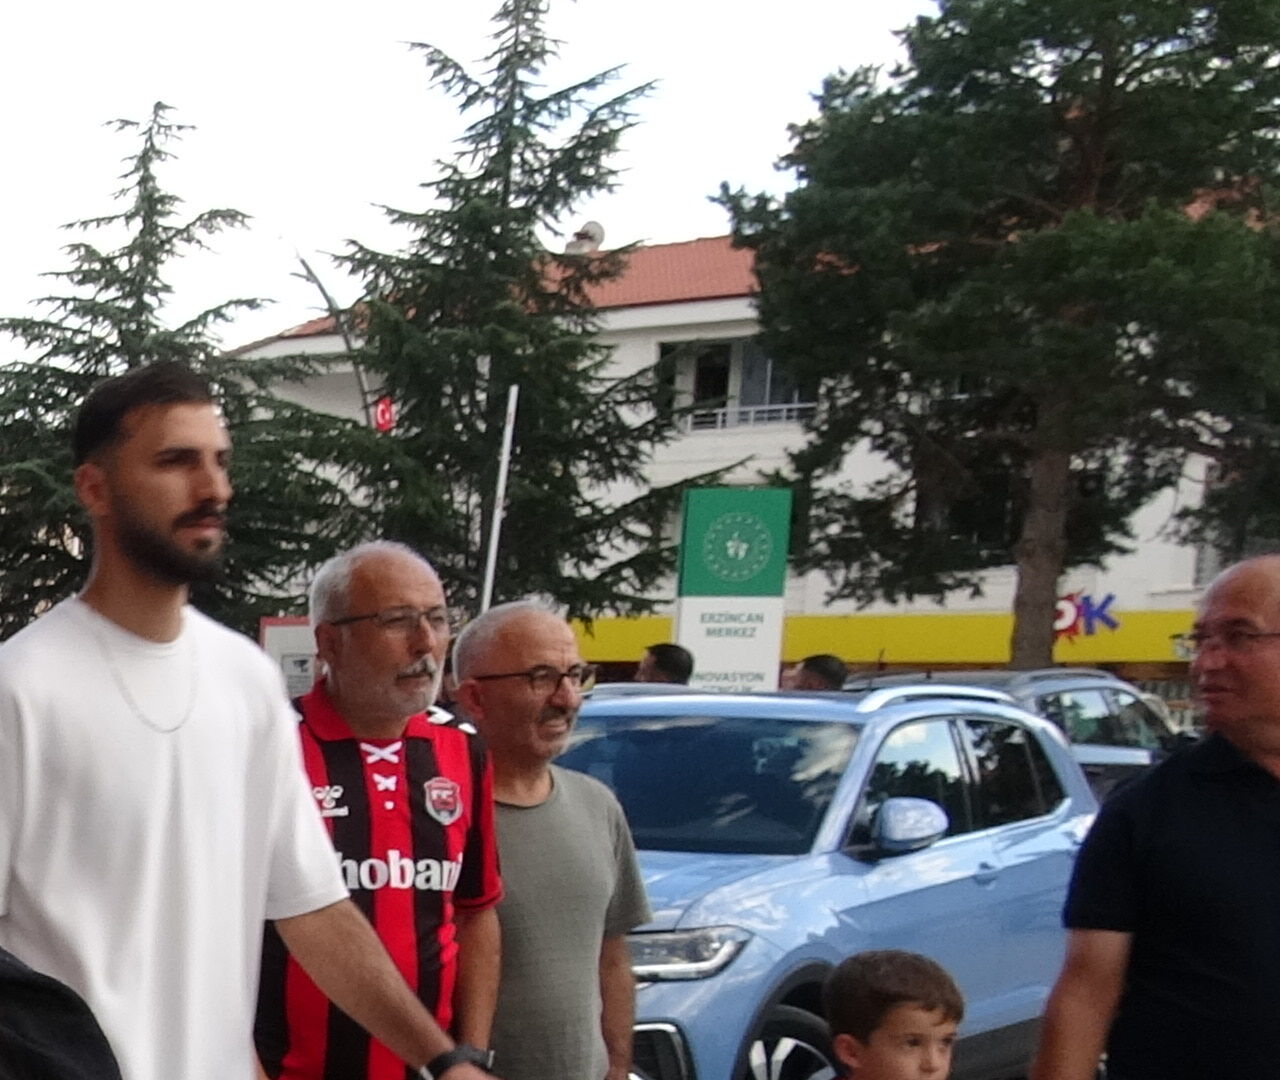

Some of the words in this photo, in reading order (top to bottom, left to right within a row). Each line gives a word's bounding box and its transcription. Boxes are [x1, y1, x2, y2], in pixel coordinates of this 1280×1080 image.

[1053, 592, 1119, 635] OK
[706, 627, 757, 638] MERKEZ
[692, 671, 764, 682] NOVASYON
